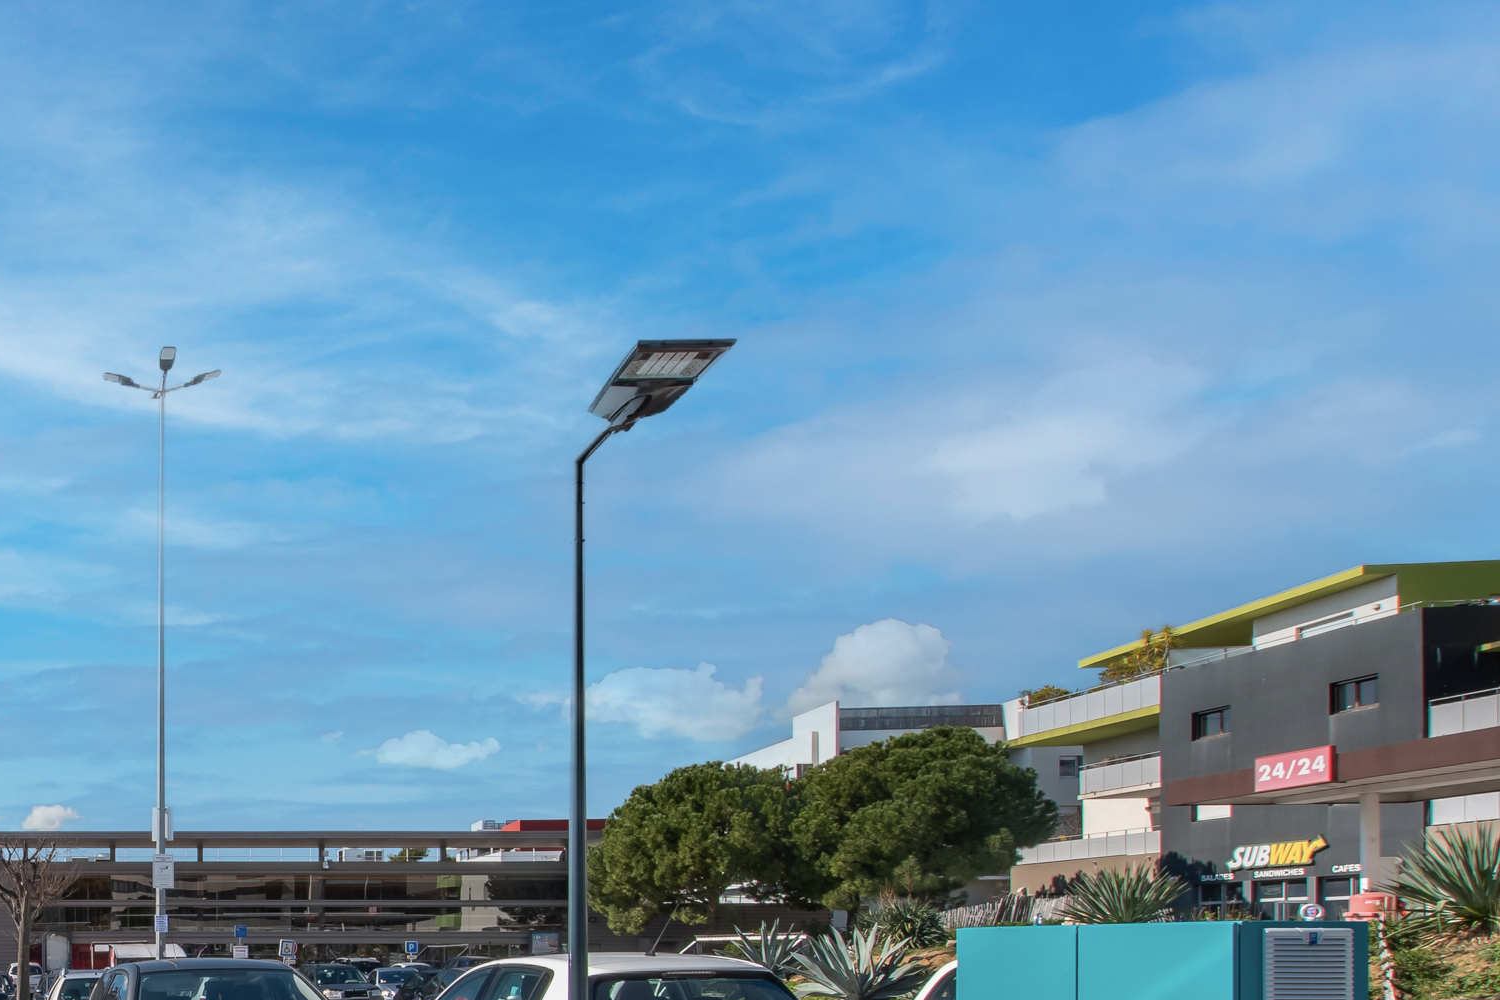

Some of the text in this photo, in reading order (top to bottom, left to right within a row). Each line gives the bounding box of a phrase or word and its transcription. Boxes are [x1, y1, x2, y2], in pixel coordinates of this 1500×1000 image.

[1258, 754, 1326, 782] 24/24
[1227, 835, 1326, 869] SUBWAY
[1201, 872, 1235, 881] SALADES
[1253, 868, 1306, 878] SANDWICHES
